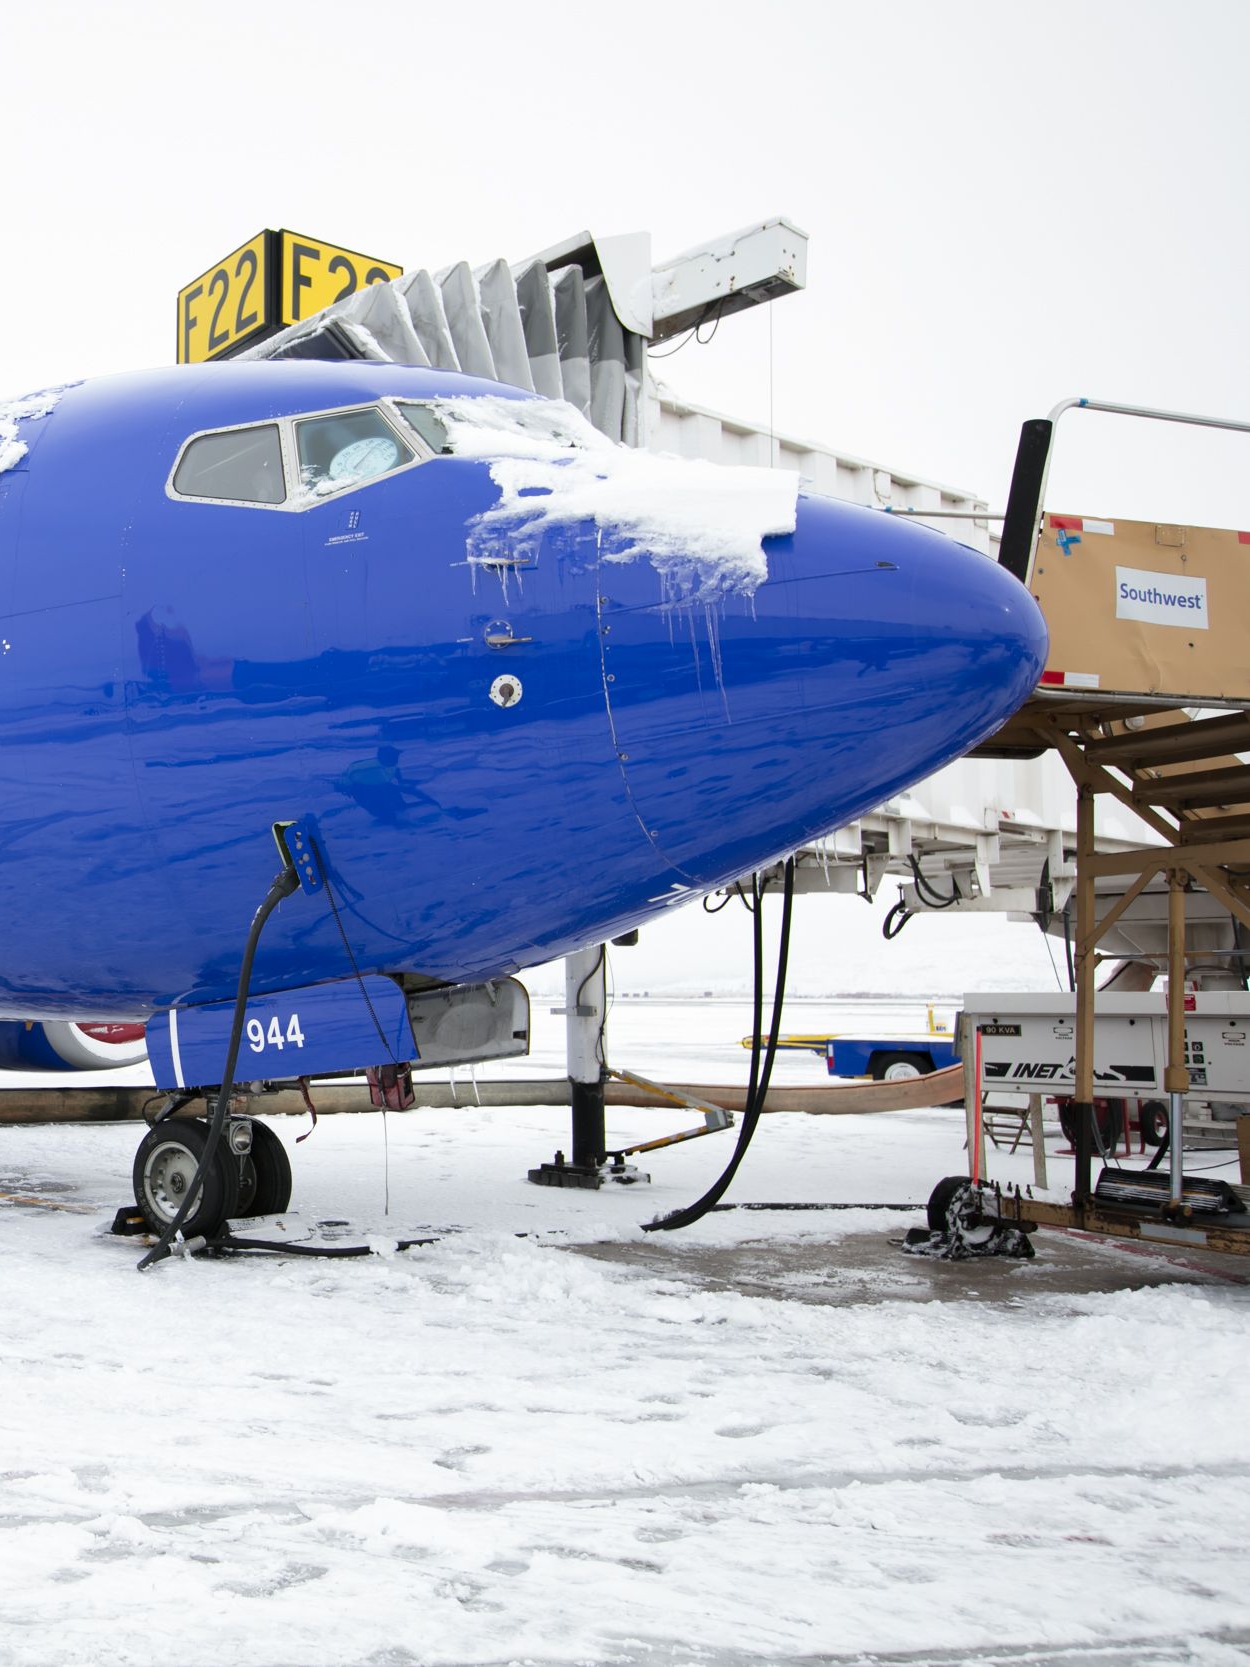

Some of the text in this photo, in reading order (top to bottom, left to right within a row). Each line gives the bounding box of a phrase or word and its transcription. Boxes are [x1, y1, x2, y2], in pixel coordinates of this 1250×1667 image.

[184, 249, 258, 363] F22
[1119, 583, 1202, 610] Southwest
[246, 1013, 305, 1053] 944
[985, 1025, 1016, 1034] 90 KVA
